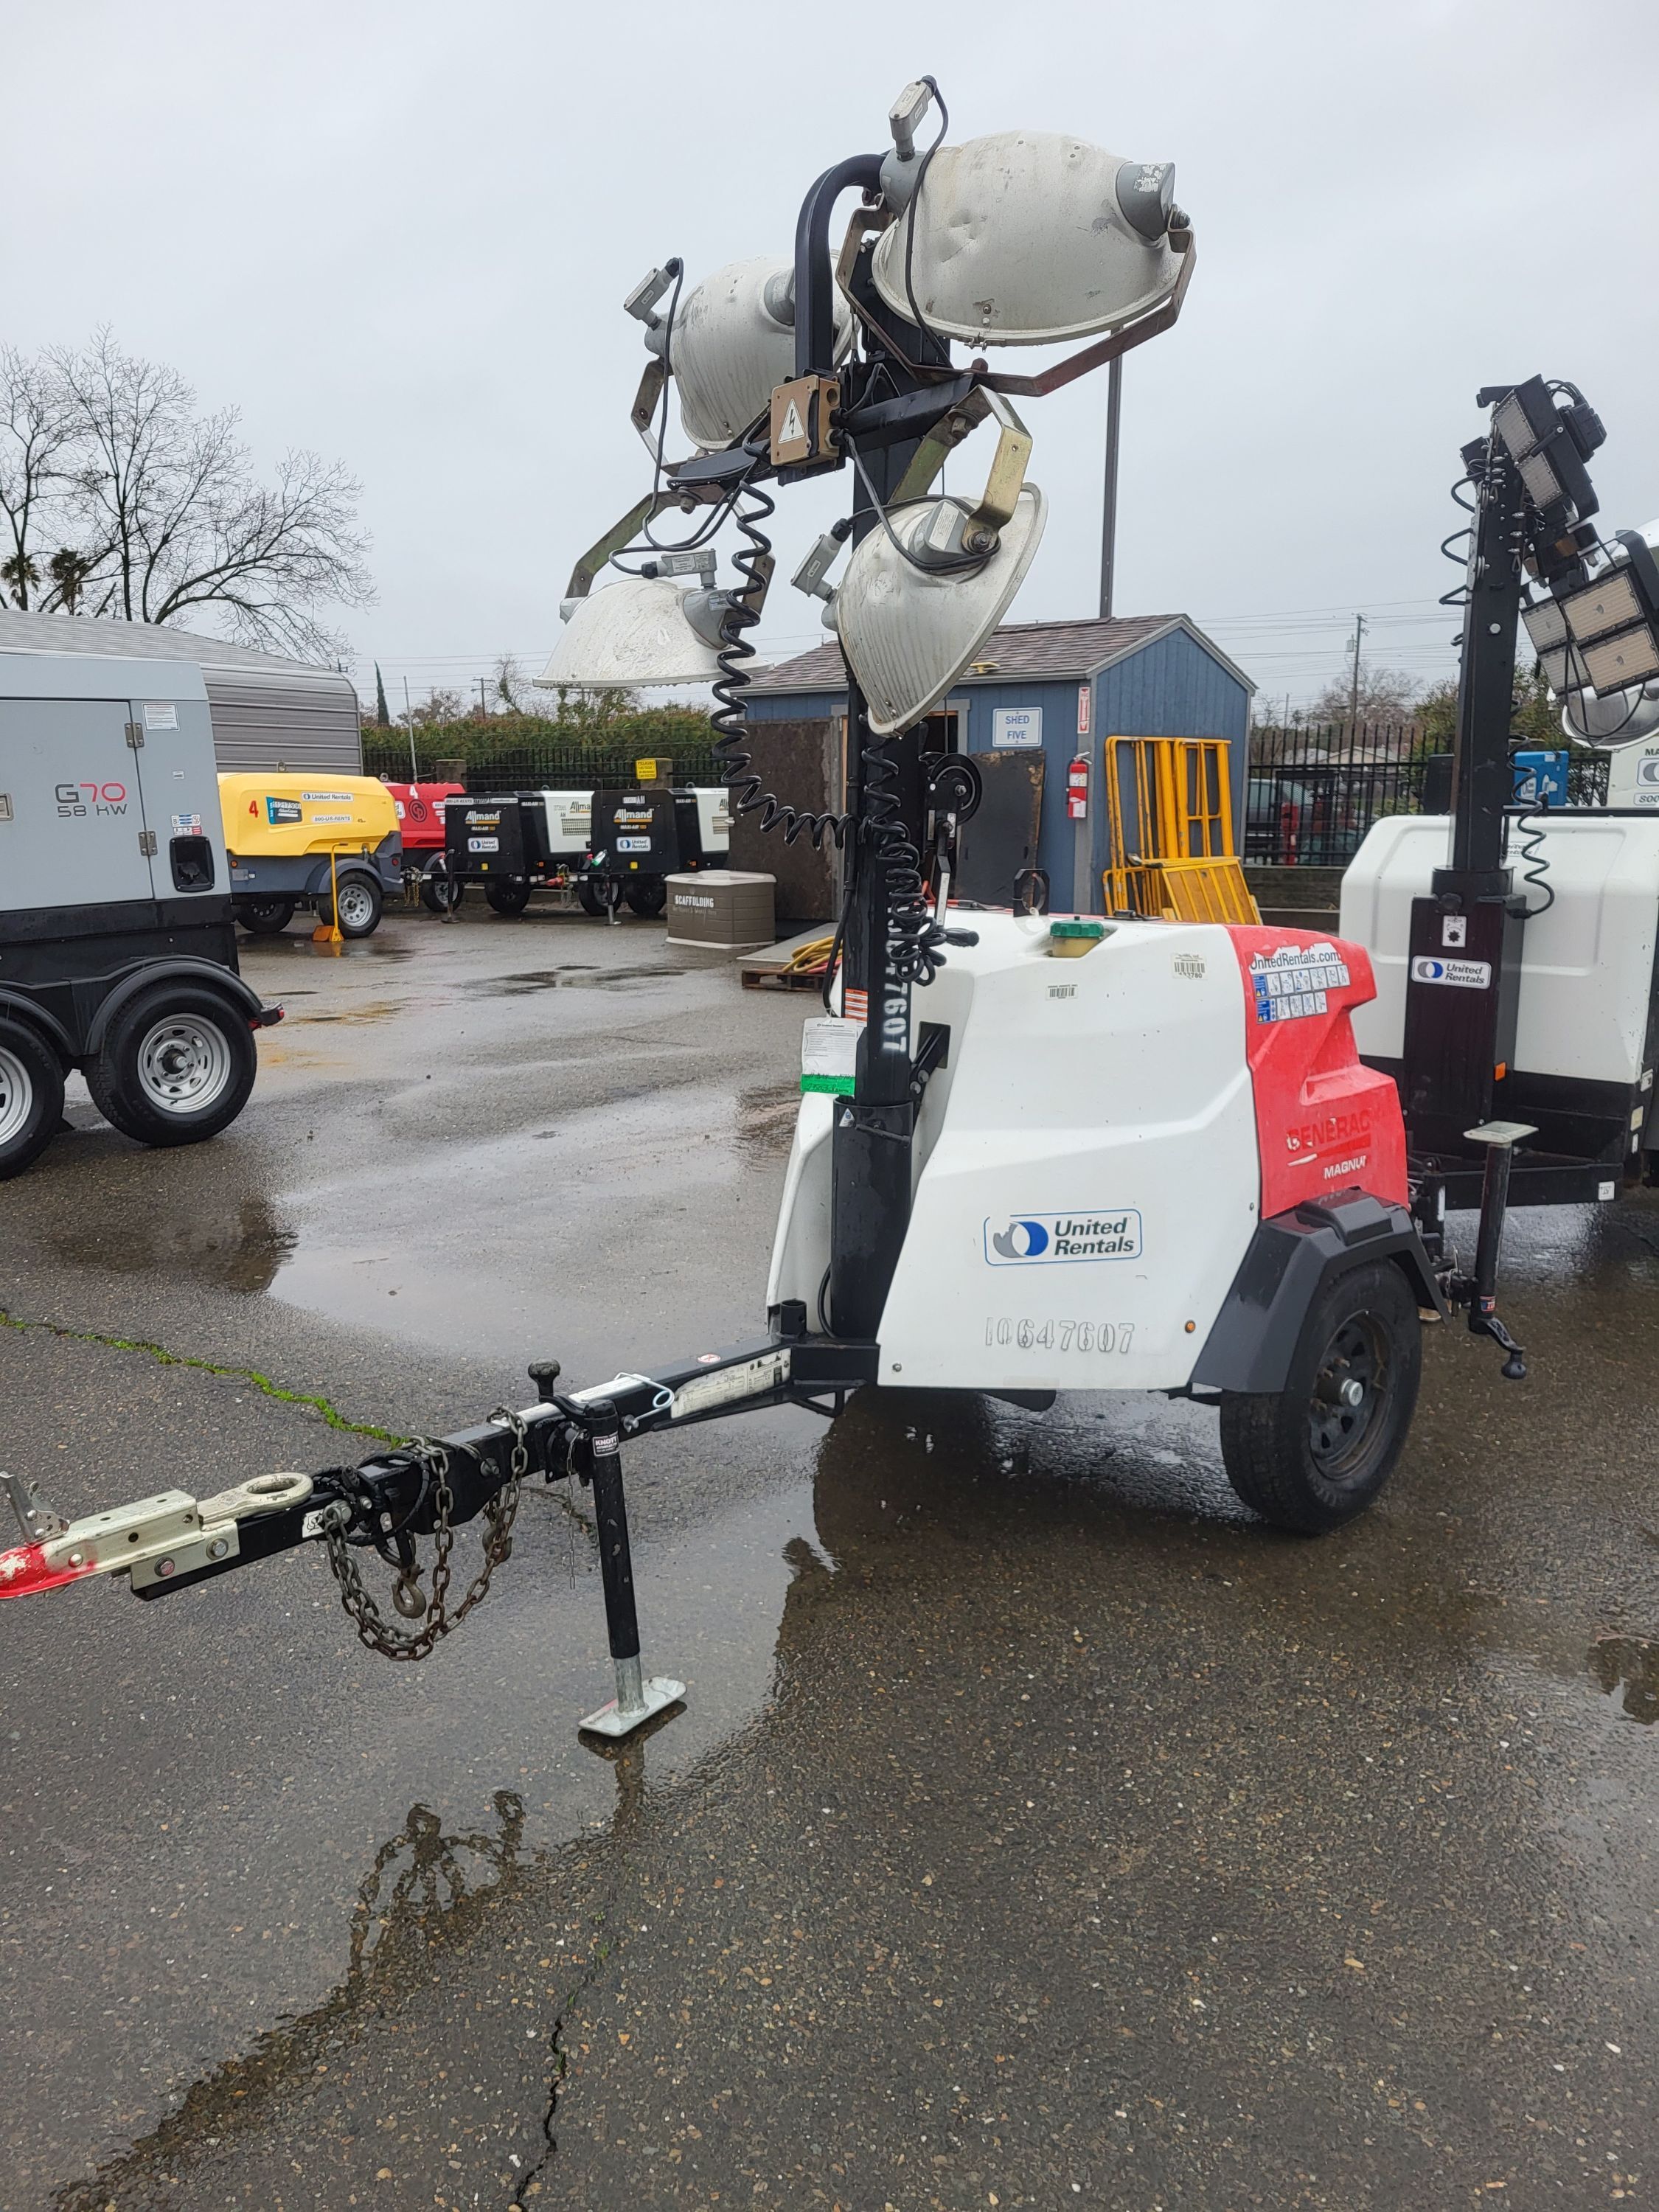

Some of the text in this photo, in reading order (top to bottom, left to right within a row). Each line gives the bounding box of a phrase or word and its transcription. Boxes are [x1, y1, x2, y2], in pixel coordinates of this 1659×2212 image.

[1005, 715, 1030, 725] SHED
[1006, 730, 1027, 740] FIVE
[55, 783, 126, 804] G70
[409, 785, 419, 799] 4
[57, 805, 87, 818] 58
[249, 800, 259, 818] 4
[613, 808, 653, 823] Allmand
[465, 810, 501, 824] Allmand
[674, 894, 714, 908] SCAFFOLDING
[1446, 963, 1484, 975] United
[1444, 972, 1486, 985] Rentals
[1286, 1108, 1371, 1153] GENERAC
[1054, 1217, 1128, 1237] United
[1054, 1236, 1135, 1256] Rentals
[985, 1316, 1135, 1354] 10647607
[595, 1436, 617, 1446] KNOTT
